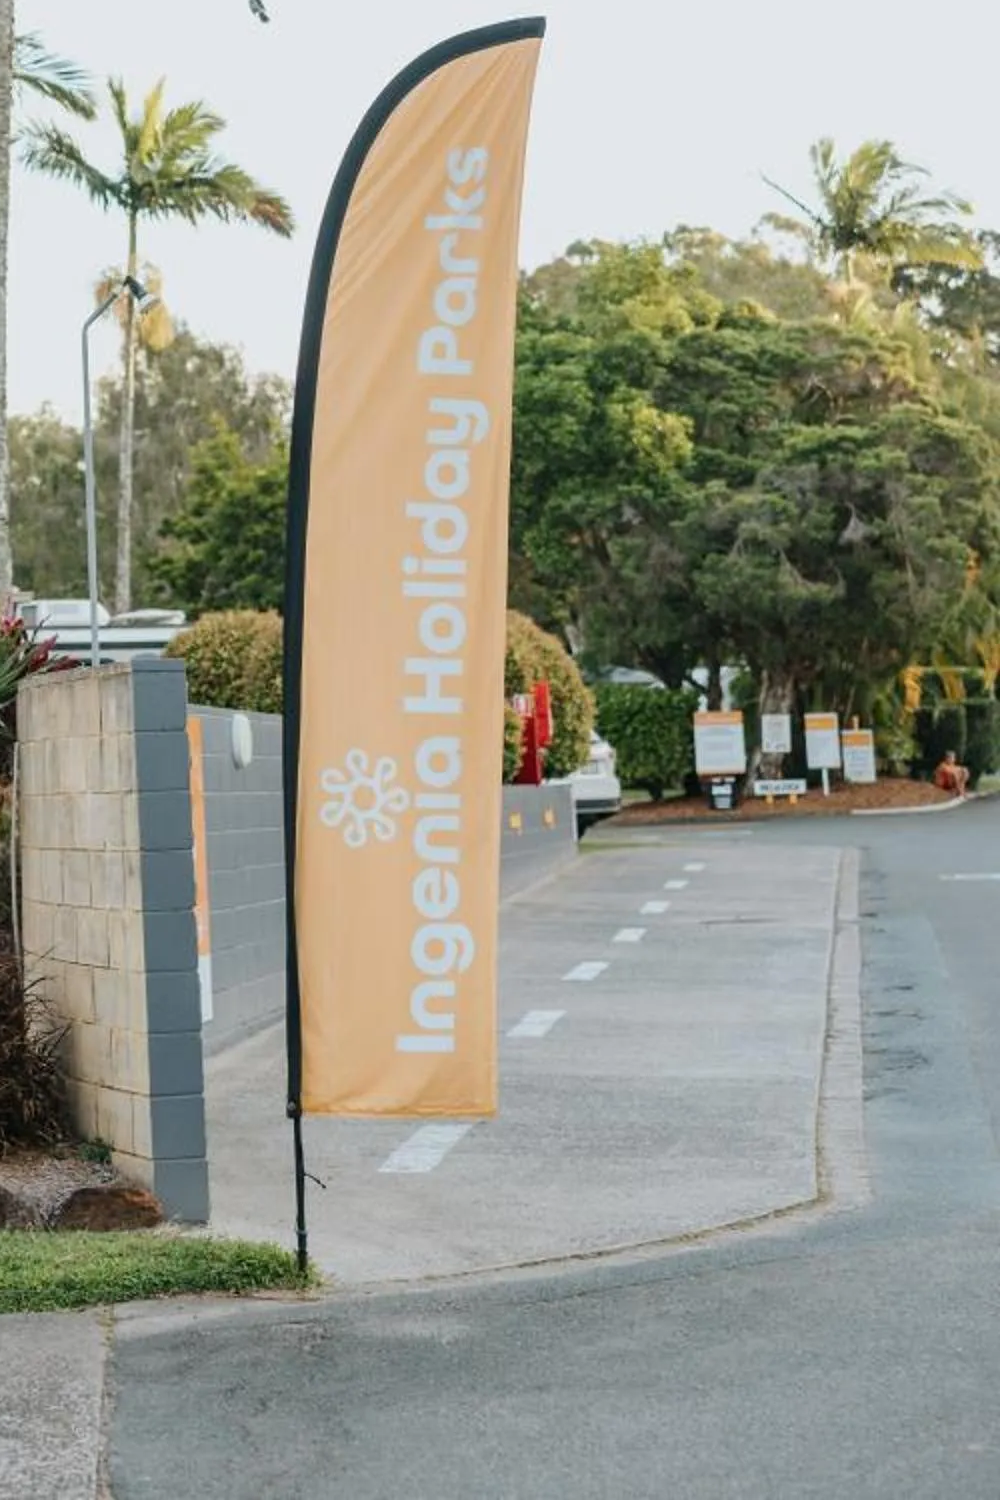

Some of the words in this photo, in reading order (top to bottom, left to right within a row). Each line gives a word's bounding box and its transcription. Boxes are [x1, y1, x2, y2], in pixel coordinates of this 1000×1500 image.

[416, 148, 489, 374] Parks
[400, 398, 490, 714] Holiday
[397, 736, 475, 1054] Ingenia
